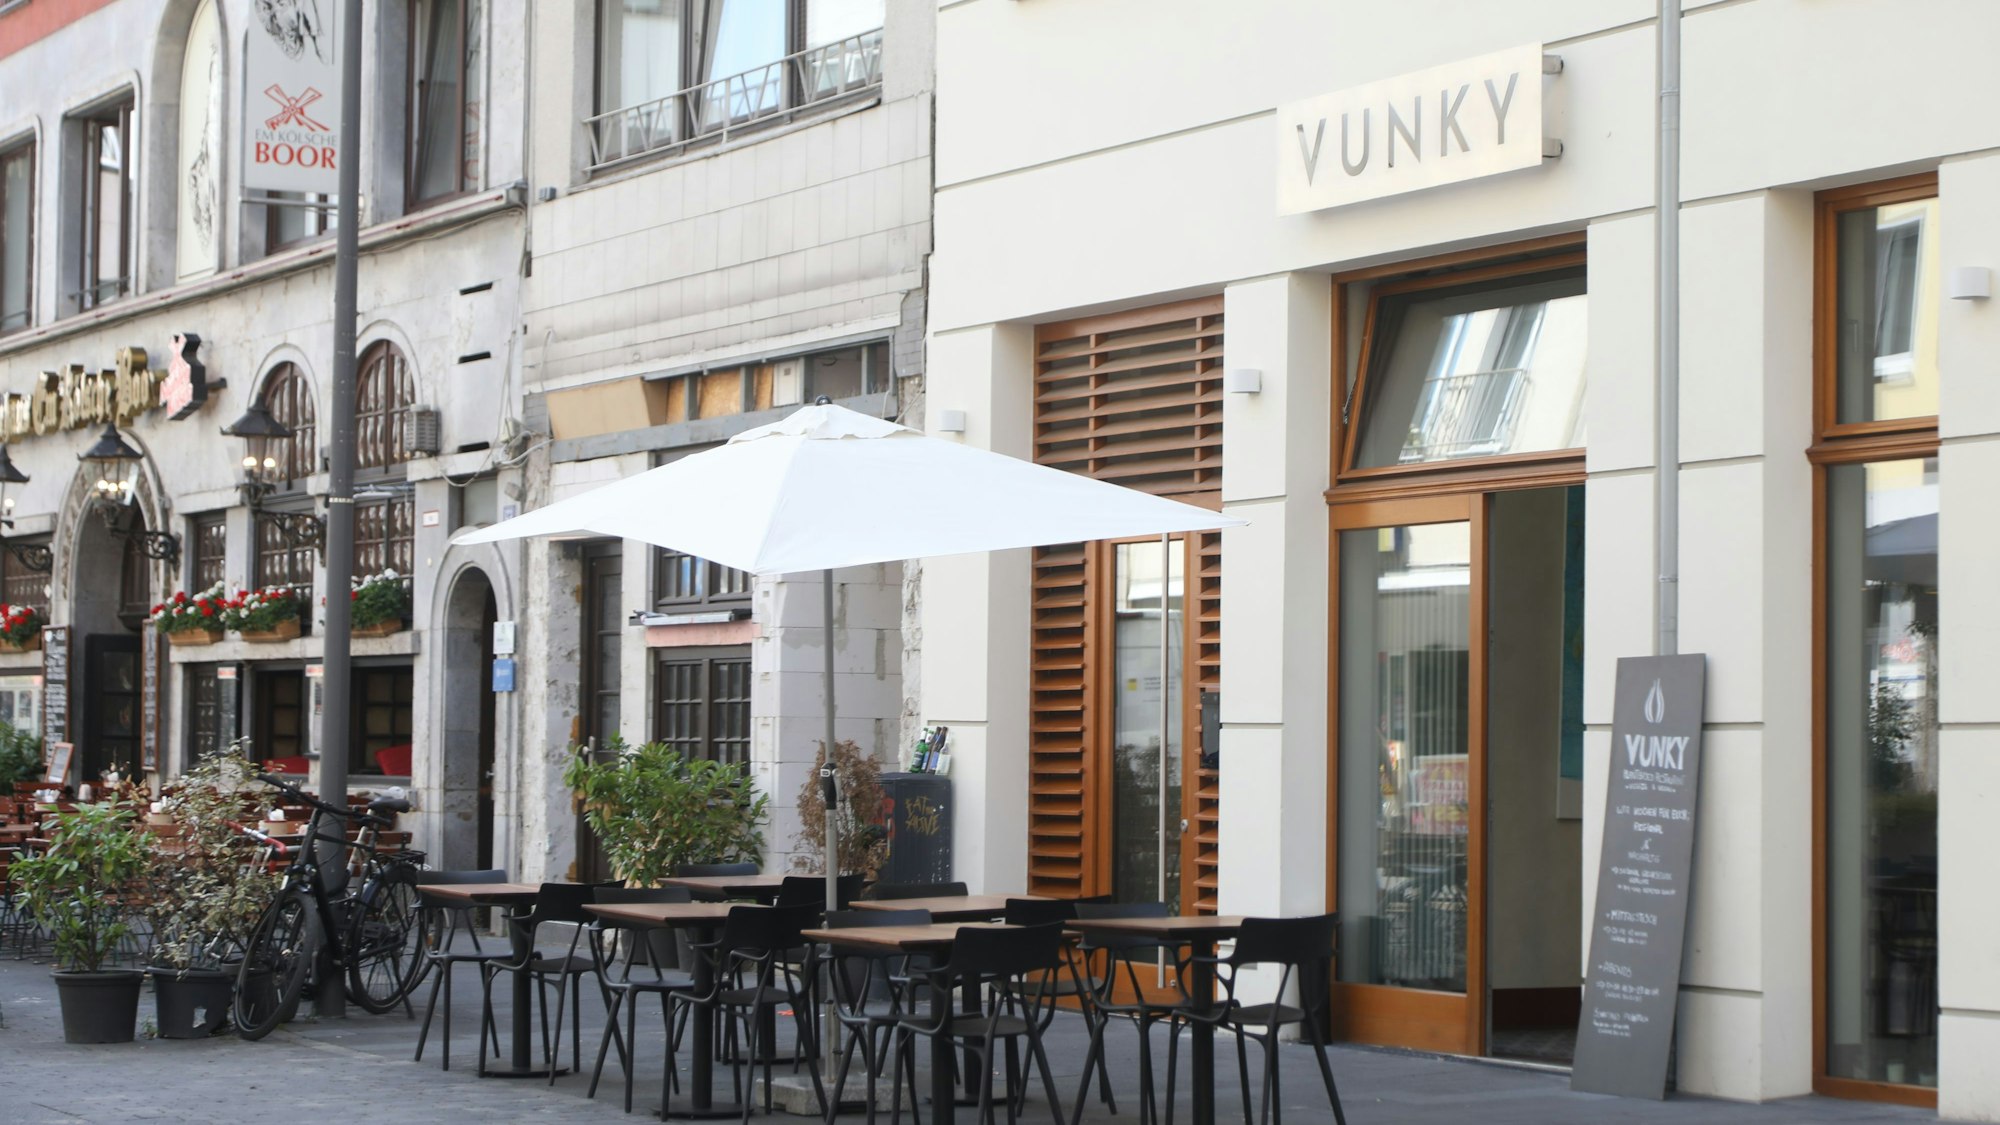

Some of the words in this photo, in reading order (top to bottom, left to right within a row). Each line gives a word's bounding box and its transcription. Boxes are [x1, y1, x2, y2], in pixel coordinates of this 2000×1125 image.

[255, 129, 274, 141] EM
[1296, 72, 1519, 187] VUNKY
[255, 141, 336, 169] BOOR
[1625, 734, 1690, 770] VUNKY
